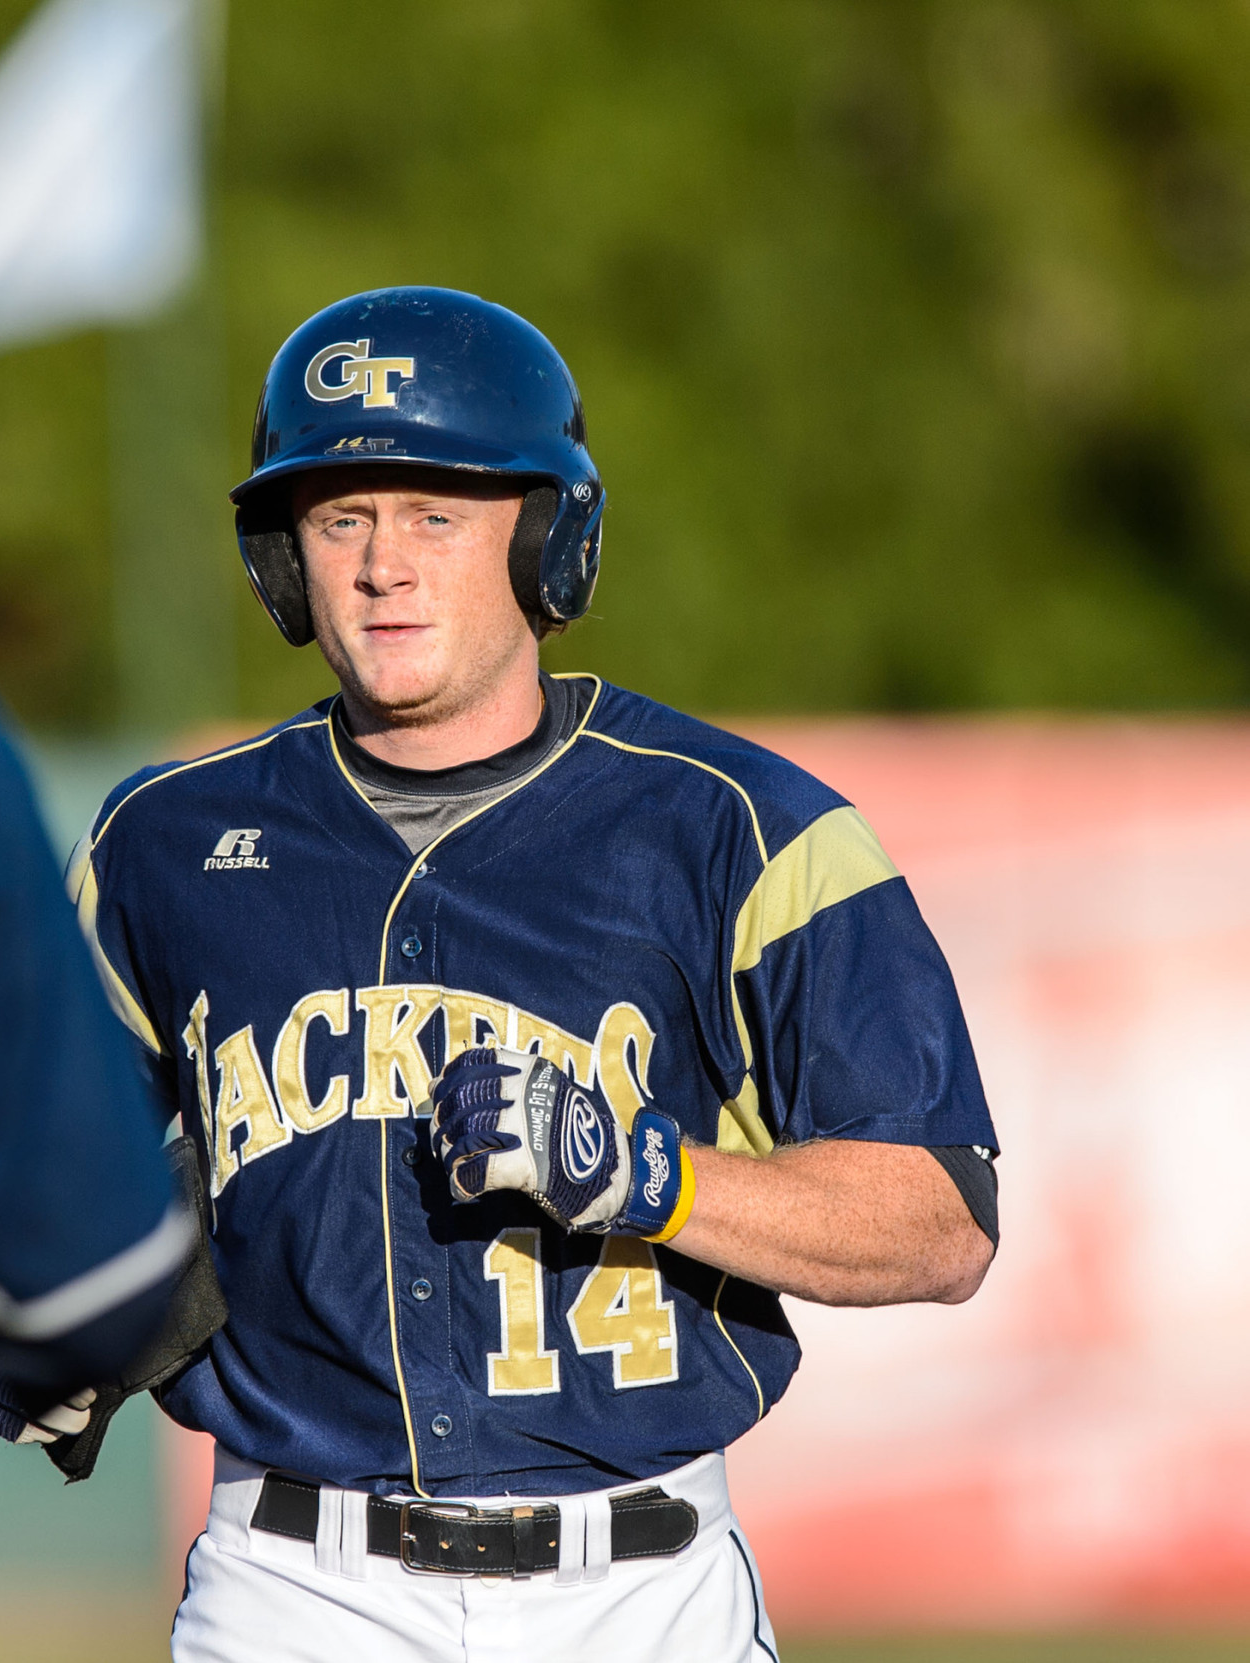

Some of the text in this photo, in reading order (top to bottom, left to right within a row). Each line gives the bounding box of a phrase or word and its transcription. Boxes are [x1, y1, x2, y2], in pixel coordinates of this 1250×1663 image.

[305, 338, 414, 408] GT
[333, 436, 364, 449] 14
[203, 856, 270, 871] RUSSELL
[528, 1091, 547, 1106] FIT
[531, 1107, 545, 1152] DYNAMIC
[642, 1127, 670, 1207] Rawlings
[482, 1226, 680, 1397] 14
